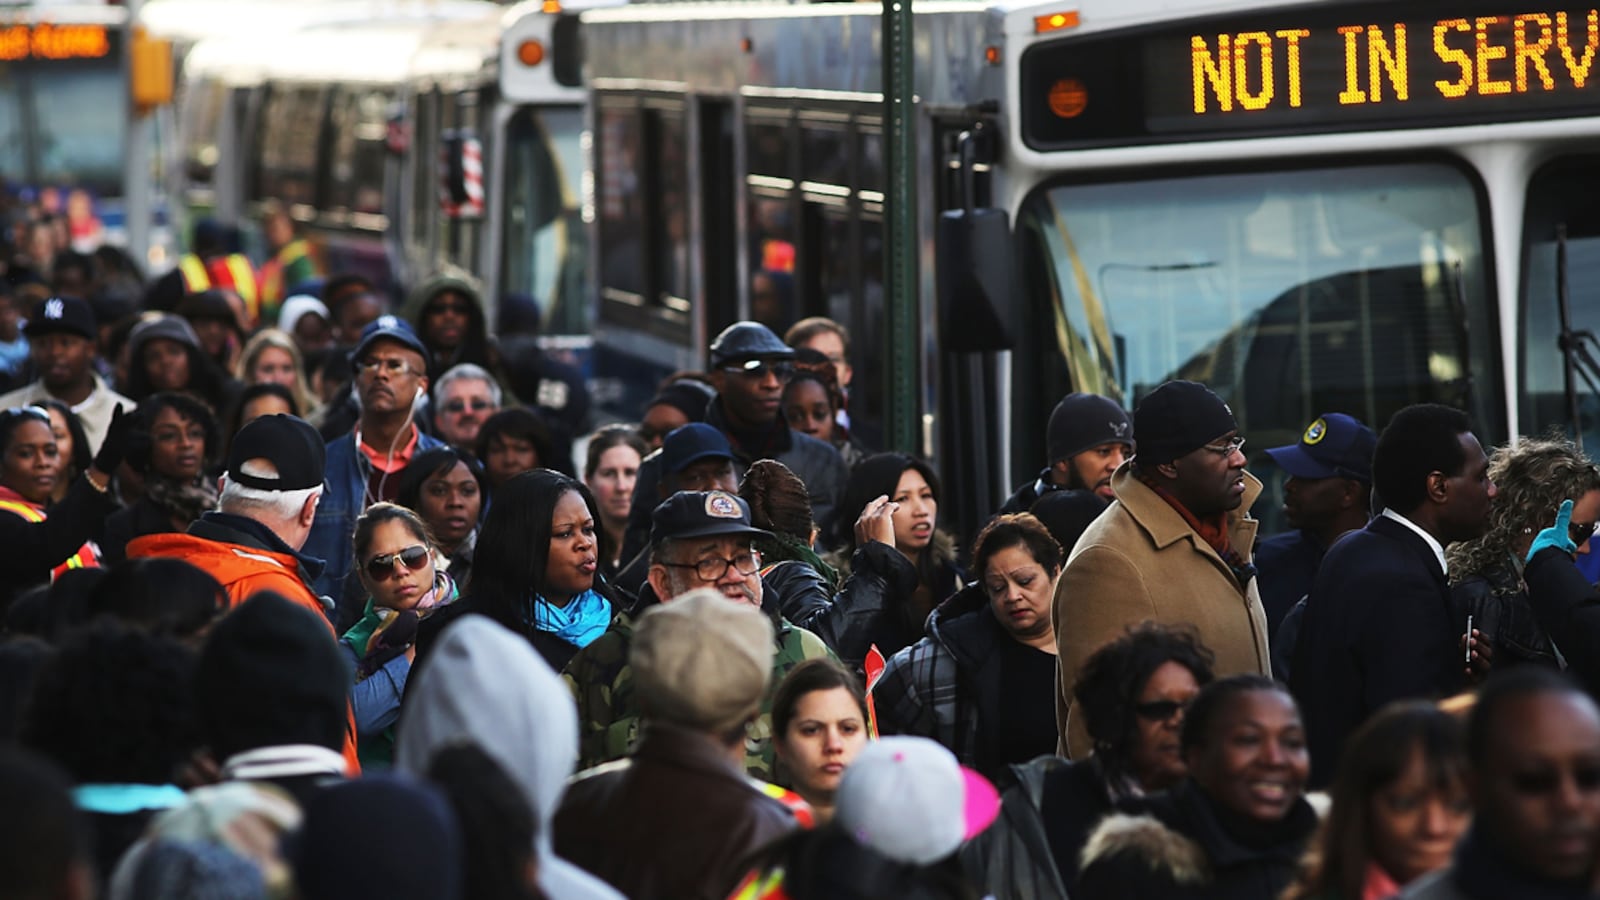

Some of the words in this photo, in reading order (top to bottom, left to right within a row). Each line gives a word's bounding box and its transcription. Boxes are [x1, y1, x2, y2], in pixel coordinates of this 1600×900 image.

[1192, 29, 1311, 113] NOT
[1338, 23, 1409, 104] IN
[1433, 10, 1600, 98] SERV
